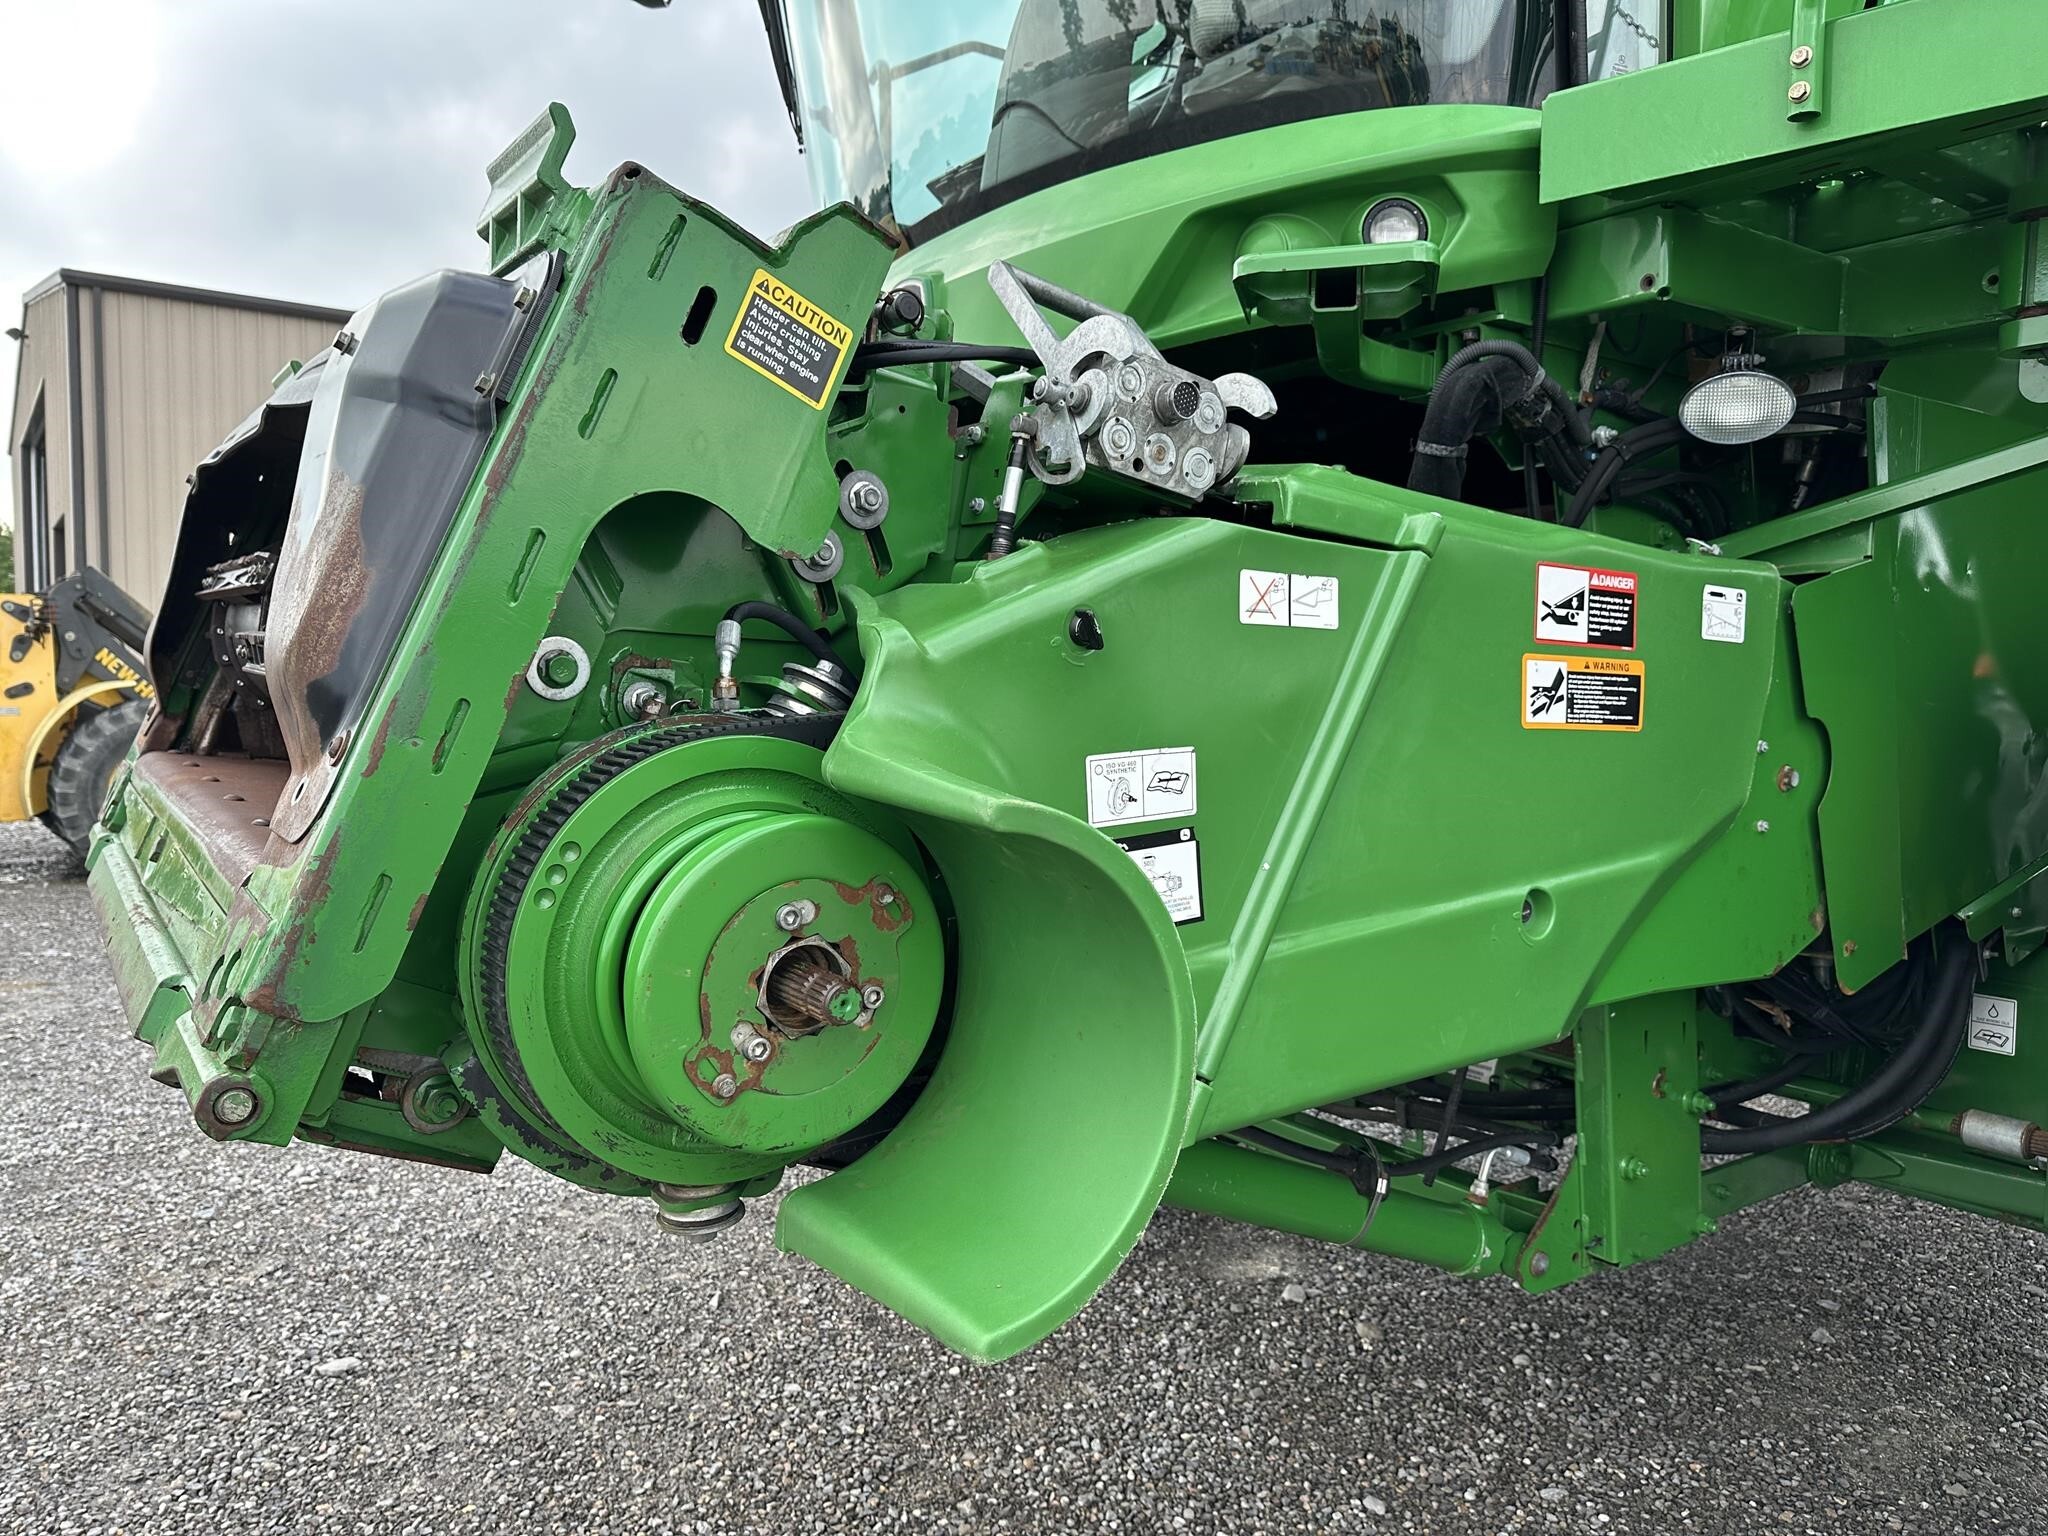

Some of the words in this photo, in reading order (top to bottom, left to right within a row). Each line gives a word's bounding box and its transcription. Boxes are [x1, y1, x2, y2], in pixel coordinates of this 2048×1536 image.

[750, 308, 779, 332] Avoid
[780, 330, 821, 361] crushing
[754, 297, 790, 325] Header
[792, 323, 810, 340] can
[812, 335, 827, 352] tilt.
[772, 286, 847, 345] CAUTION
[736, 338, 746, 350] is
[747, 345, 785, 375] running.
[741, 329, 764, 348] clear
[765, 343, 789, 364] when
[789, 360, 819, 384] engine
[745, 317, 784, 349] injuries.
[787, 344, 809, 366] Stay
[1600, 575, 1634, 590] DANGER
[95, 647, 140, 683] NEW
[1593, 662, 1630, 672] WARNING
[1106, 766, 1137, 775] SYNTHETIC
